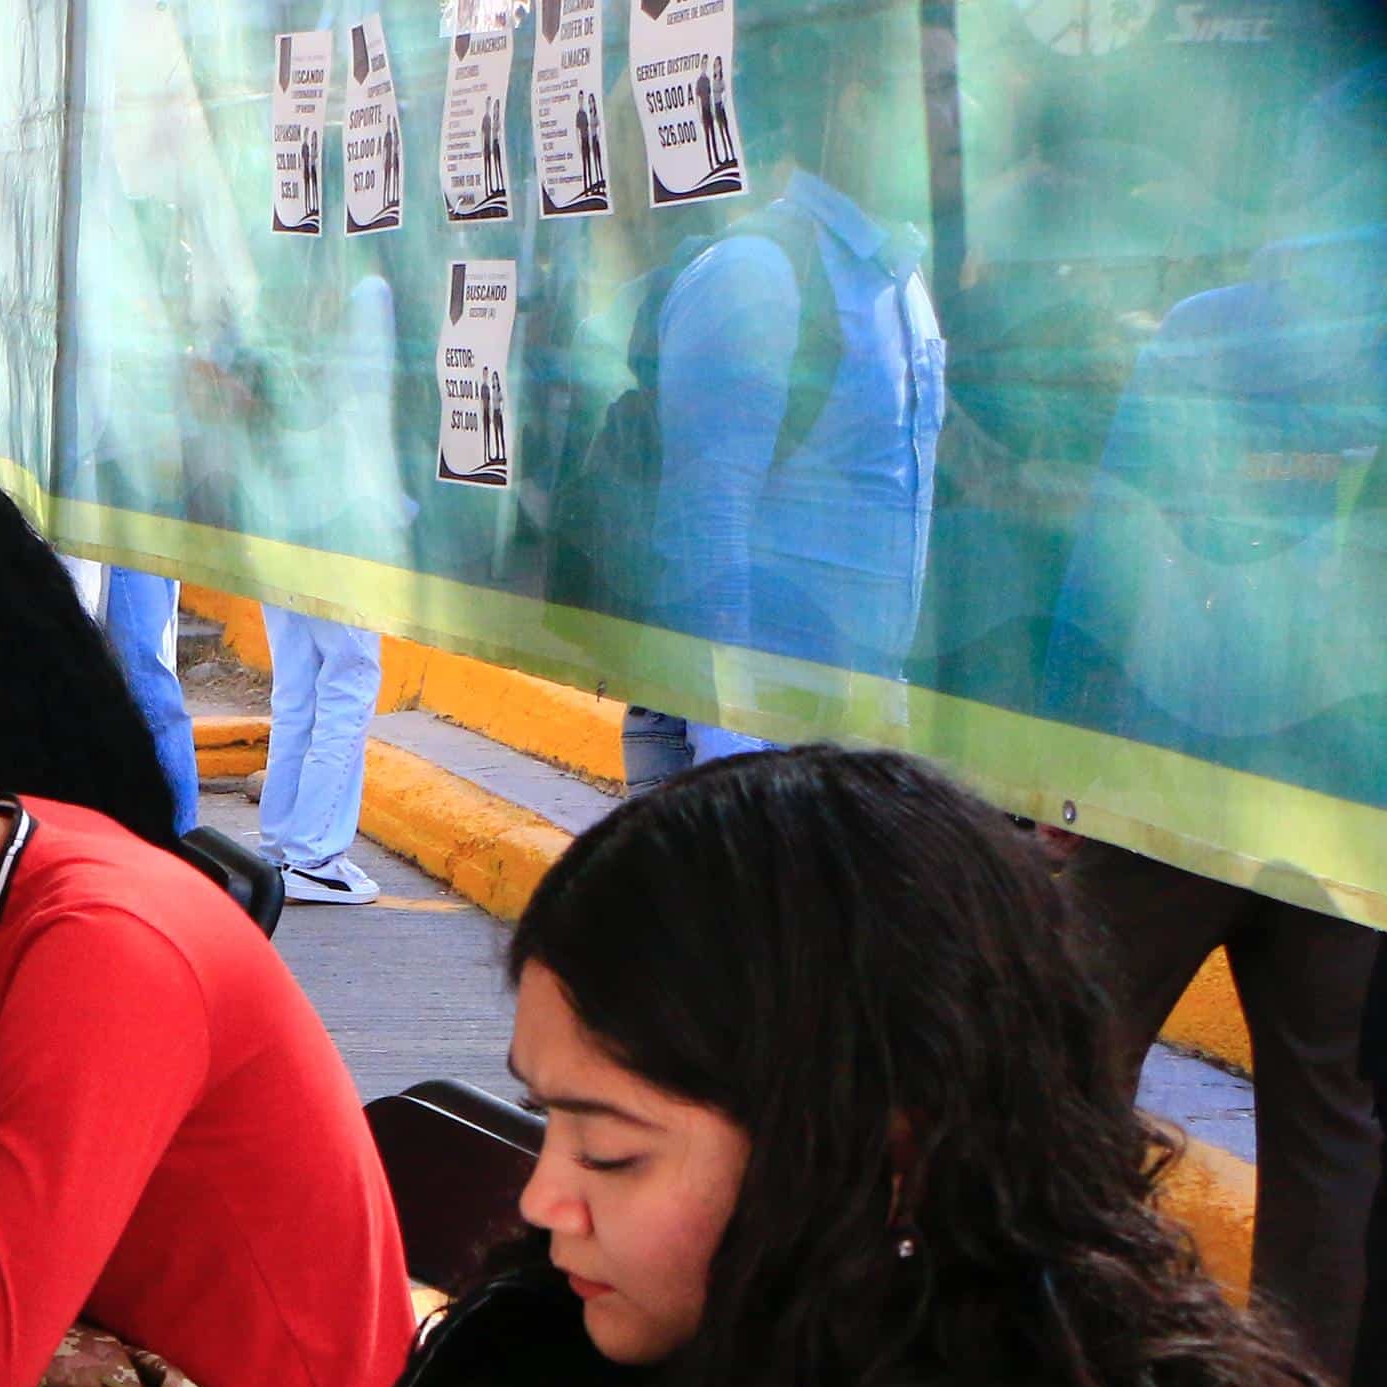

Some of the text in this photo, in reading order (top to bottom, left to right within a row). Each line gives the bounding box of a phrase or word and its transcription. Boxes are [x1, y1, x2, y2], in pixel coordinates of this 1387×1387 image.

[636, 53, 700, 82] GERENTE DISTRITO
[646, 83, 694, 114] $19,000 A
[349, 104, 382, 129] SOPORTE
[658, 121, 697, 148] $26,000
[466, 285, 507, 301] BUSCANDO
[445, 348, 475, 368] GESTOR:
